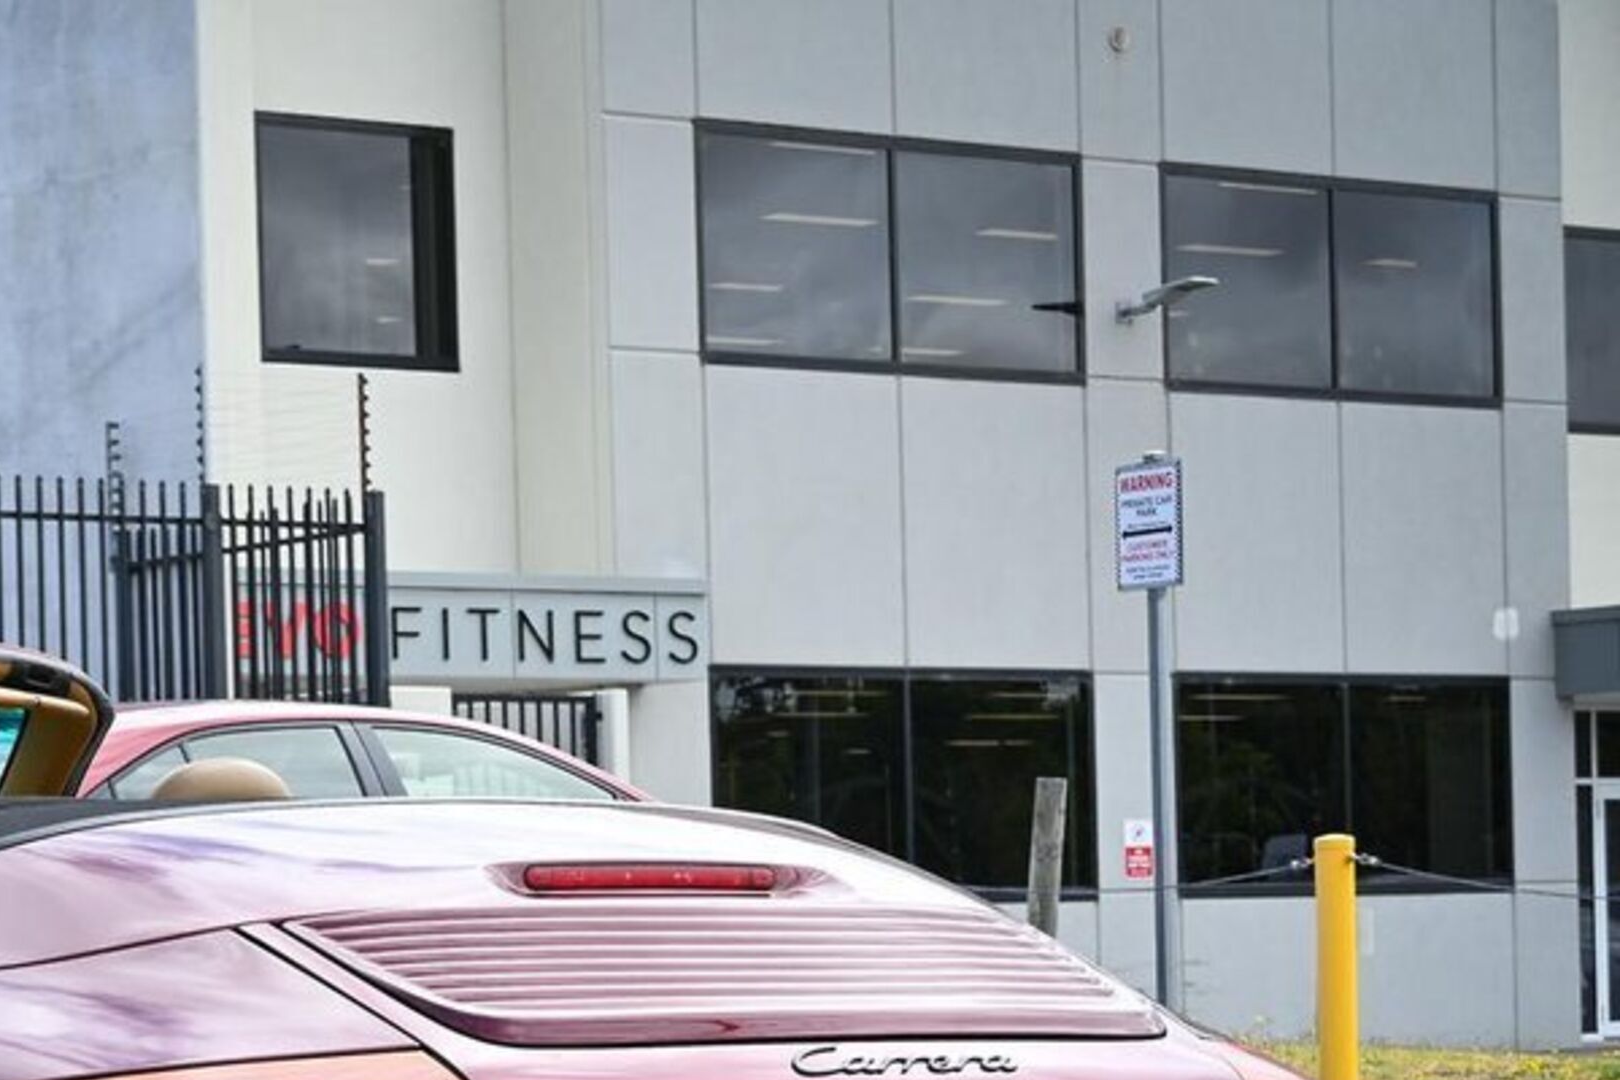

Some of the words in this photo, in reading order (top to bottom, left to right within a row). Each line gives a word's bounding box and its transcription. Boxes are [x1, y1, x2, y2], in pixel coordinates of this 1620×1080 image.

[1120, 473, 1173, 493] WARNING
[390, 606, 698, 665] FITNESS
[791, 1046, 1018, 1078] Carrera
